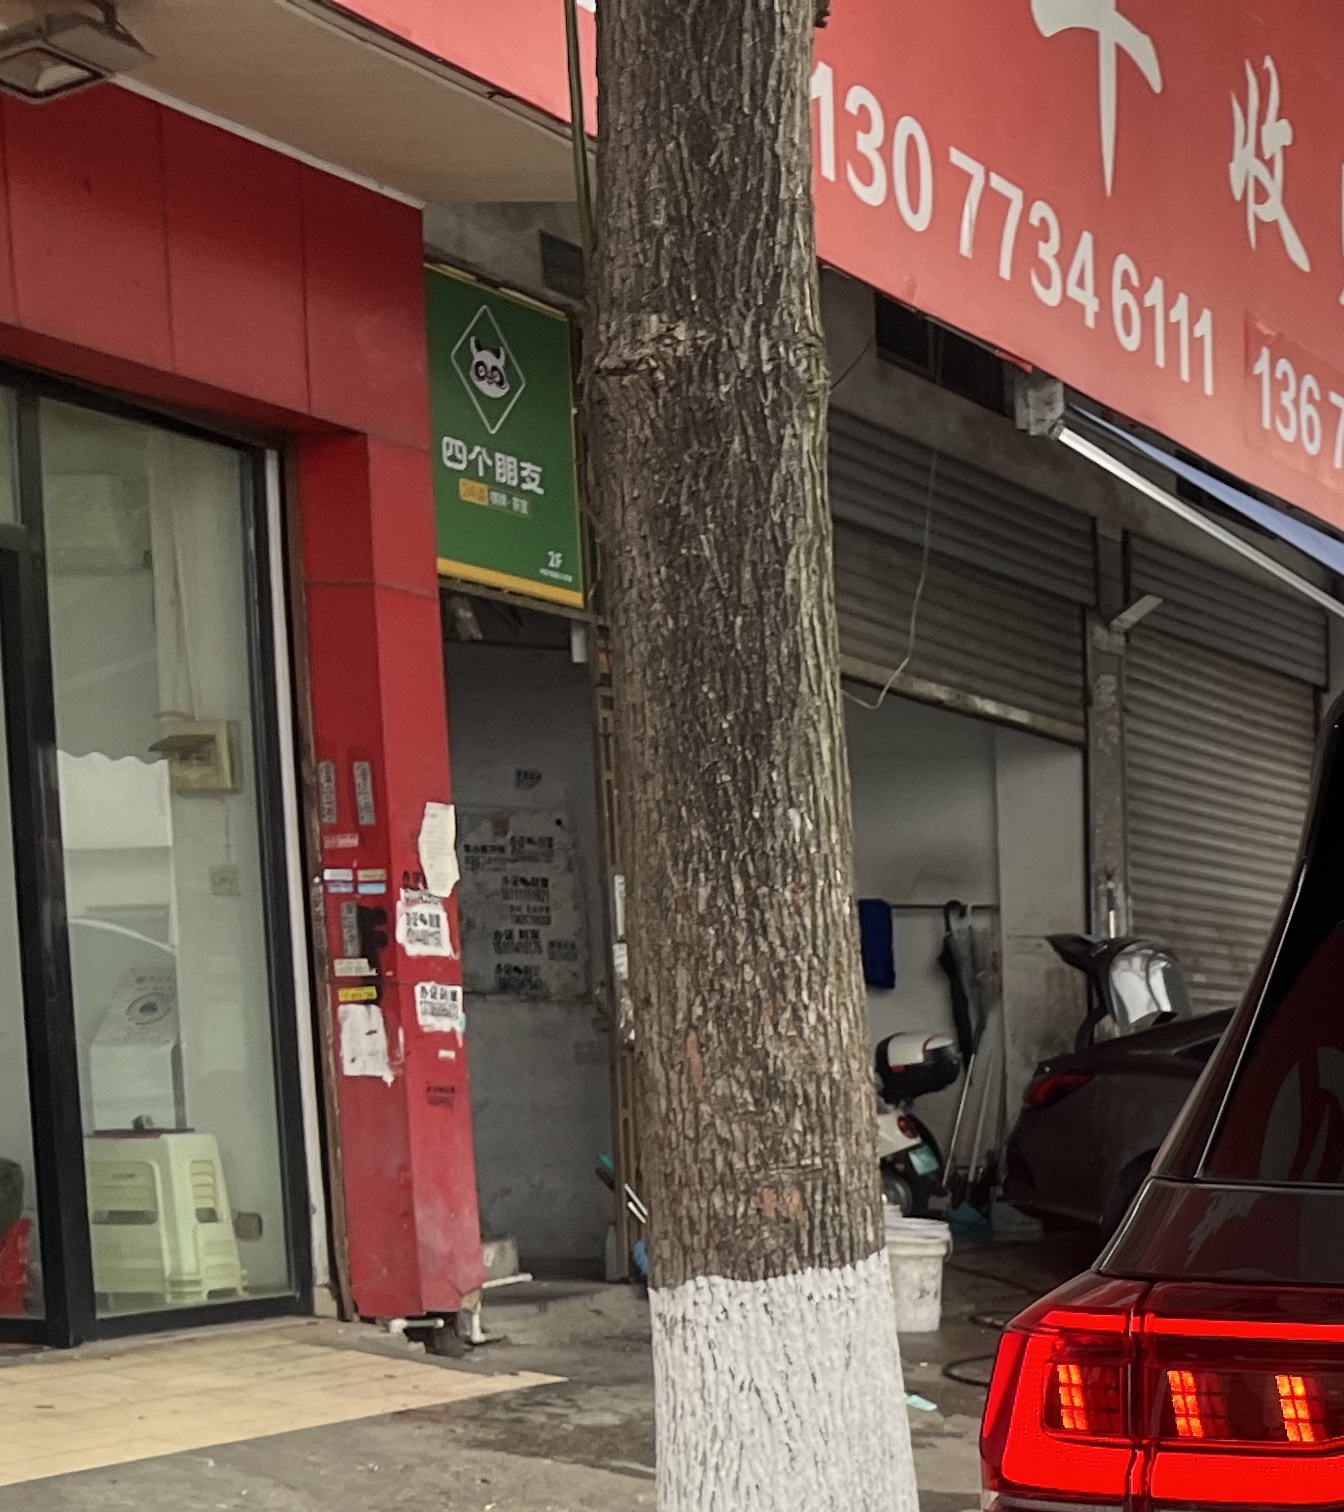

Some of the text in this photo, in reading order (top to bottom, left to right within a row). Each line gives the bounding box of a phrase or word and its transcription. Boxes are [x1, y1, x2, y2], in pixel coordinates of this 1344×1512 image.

[809, 60, 1214, 397] 130 7734 6111
[1253, 346, 1322, 455] 136
[442, 436, 544, 495] 四个朋友
